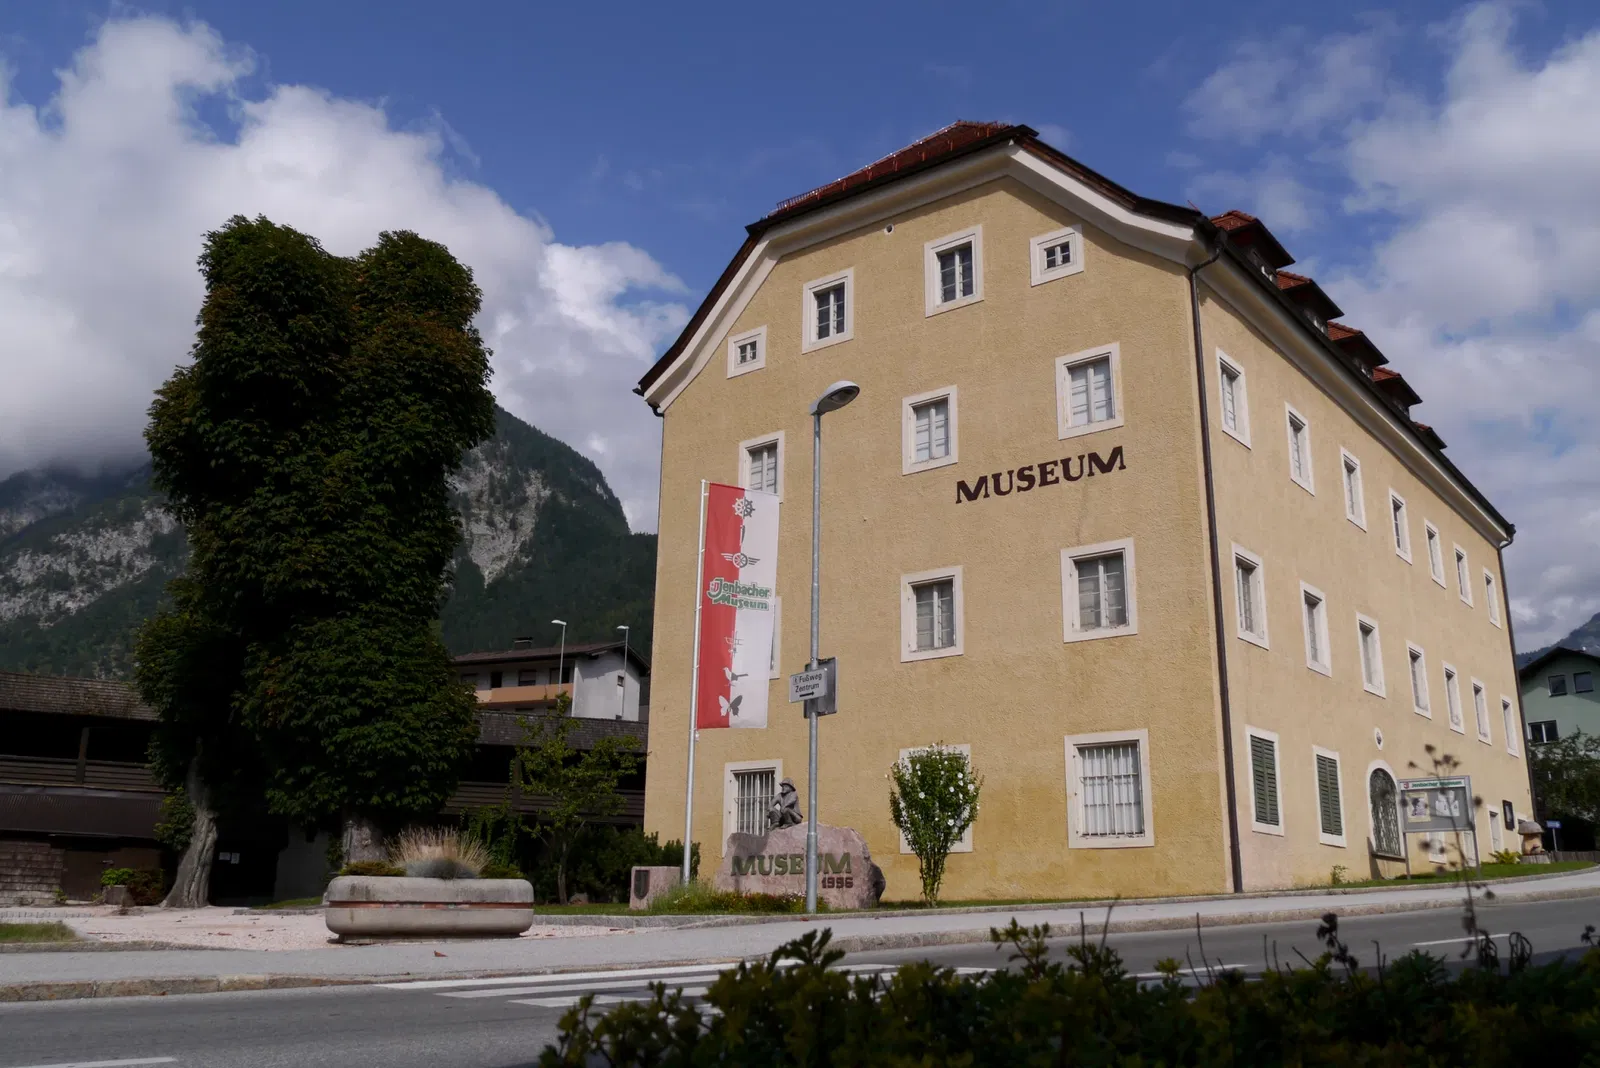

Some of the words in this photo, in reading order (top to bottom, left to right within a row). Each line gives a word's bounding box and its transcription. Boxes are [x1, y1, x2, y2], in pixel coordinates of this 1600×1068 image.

[955, 445, 1127, 504] MUSEUM
[707, 578, 770, 599] Jenbacher
[713, 593, 769, 610] Museum
[795, 683, 820, 693] Zentrum
